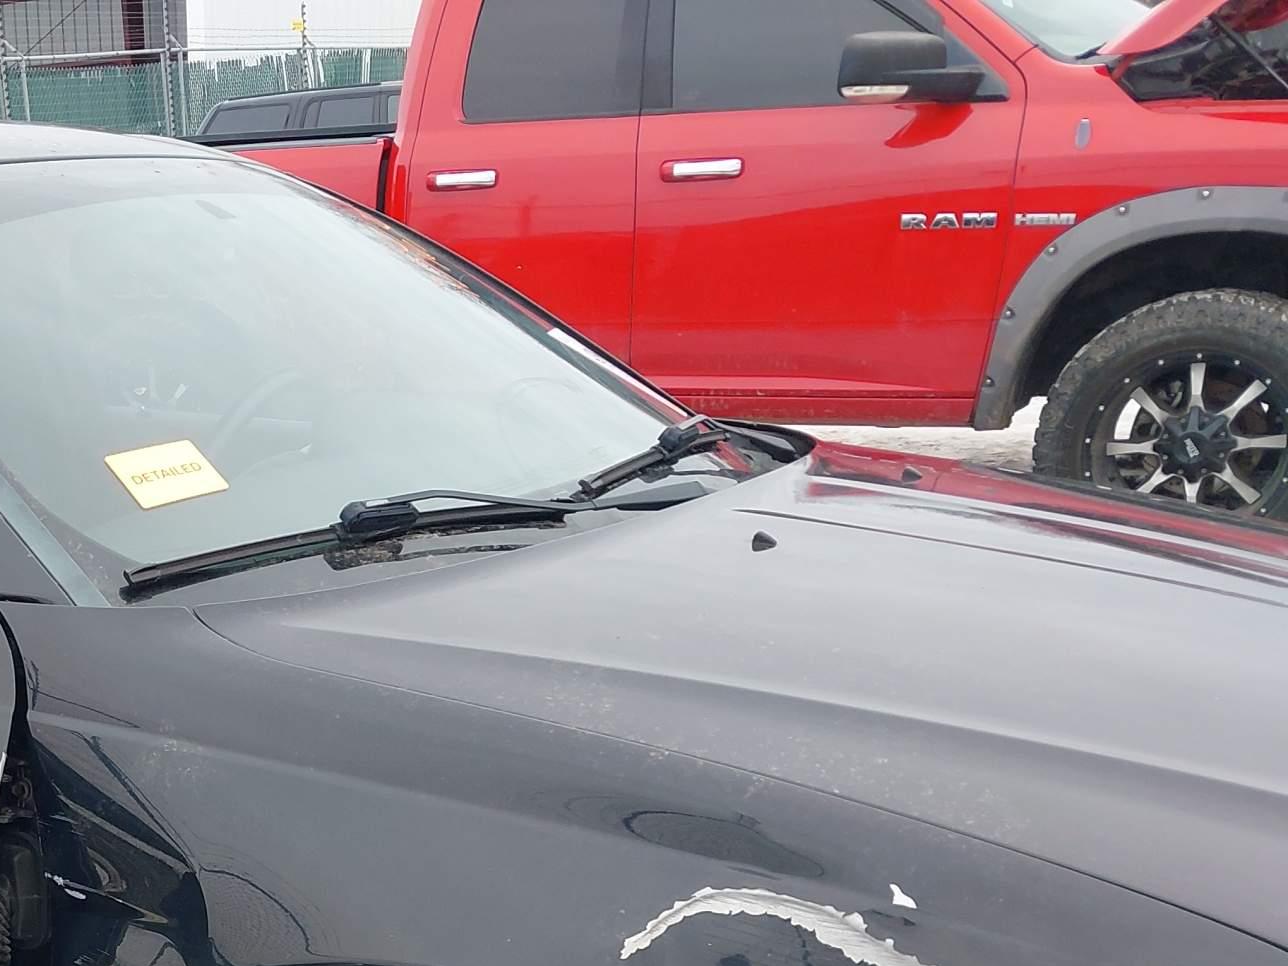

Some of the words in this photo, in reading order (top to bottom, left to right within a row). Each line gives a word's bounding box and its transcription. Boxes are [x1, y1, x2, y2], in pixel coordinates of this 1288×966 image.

[900, 212, 998, 230] RAM
[1015, 212, 1077, 226] HEMI
[130, 462, 202, 485] DETAILED
